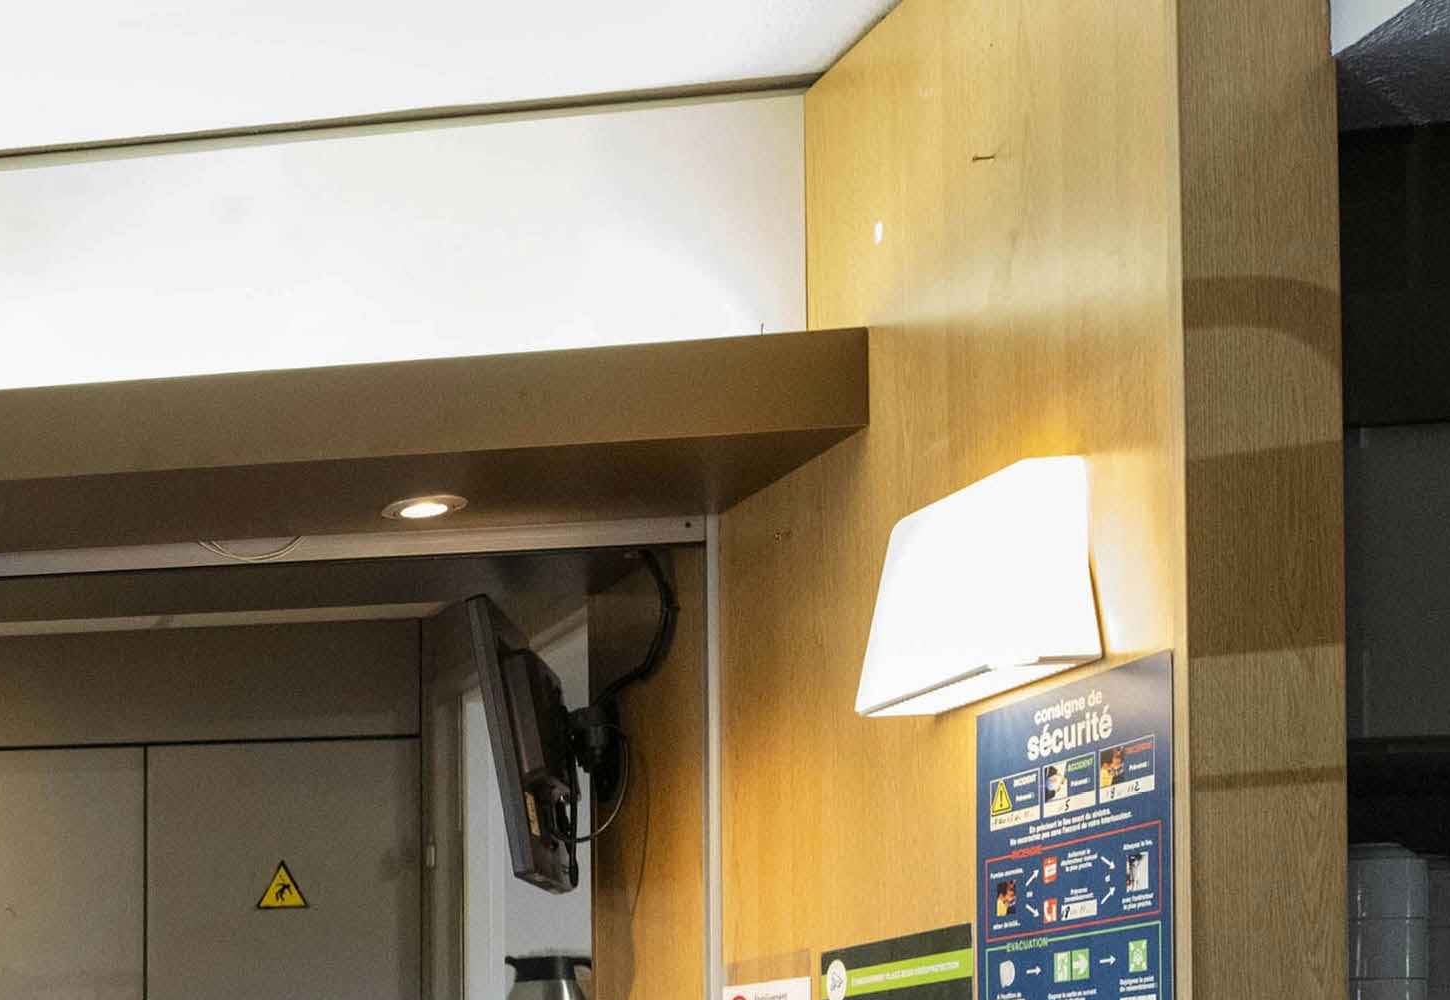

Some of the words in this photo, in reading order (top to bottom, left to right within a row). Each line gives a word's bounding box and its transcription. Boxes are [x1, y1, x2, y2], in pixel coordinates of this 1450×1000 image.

[1034, 696, 1086, 725] consigne
[1088, 690, 1103, 707] de
[1026, 705, 1113, 761] sécurité
